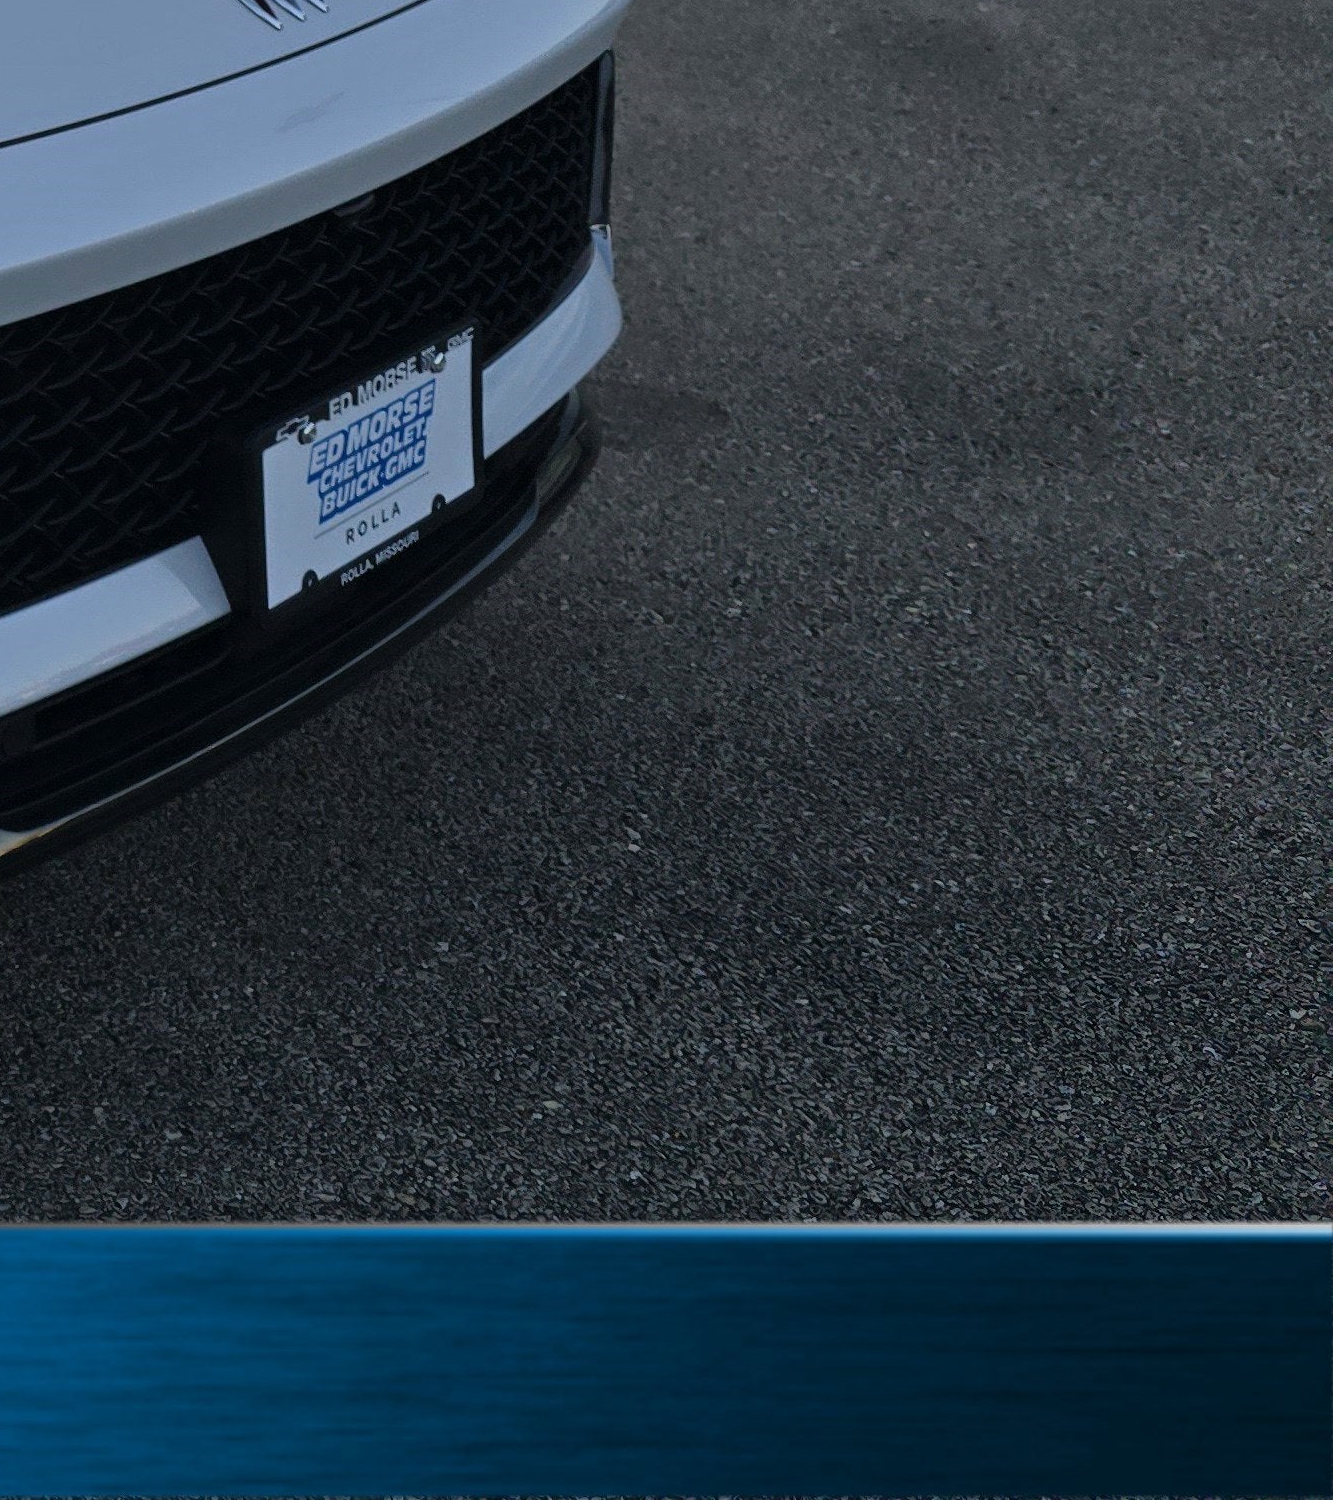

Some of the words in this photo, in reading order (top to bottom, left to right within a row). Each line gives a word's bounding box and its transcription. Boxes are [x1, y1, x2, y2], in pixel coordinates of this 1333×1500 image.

[329, 391, 354, 419] ED
[357, 355, 417, 405] MORSE
[309, 430, 346, 477] ED
[346, 381, 434, 456] MORSE
[319, 417, 426, 494] CHEVROLET
[346, 501, 401, 545] ROLLA
